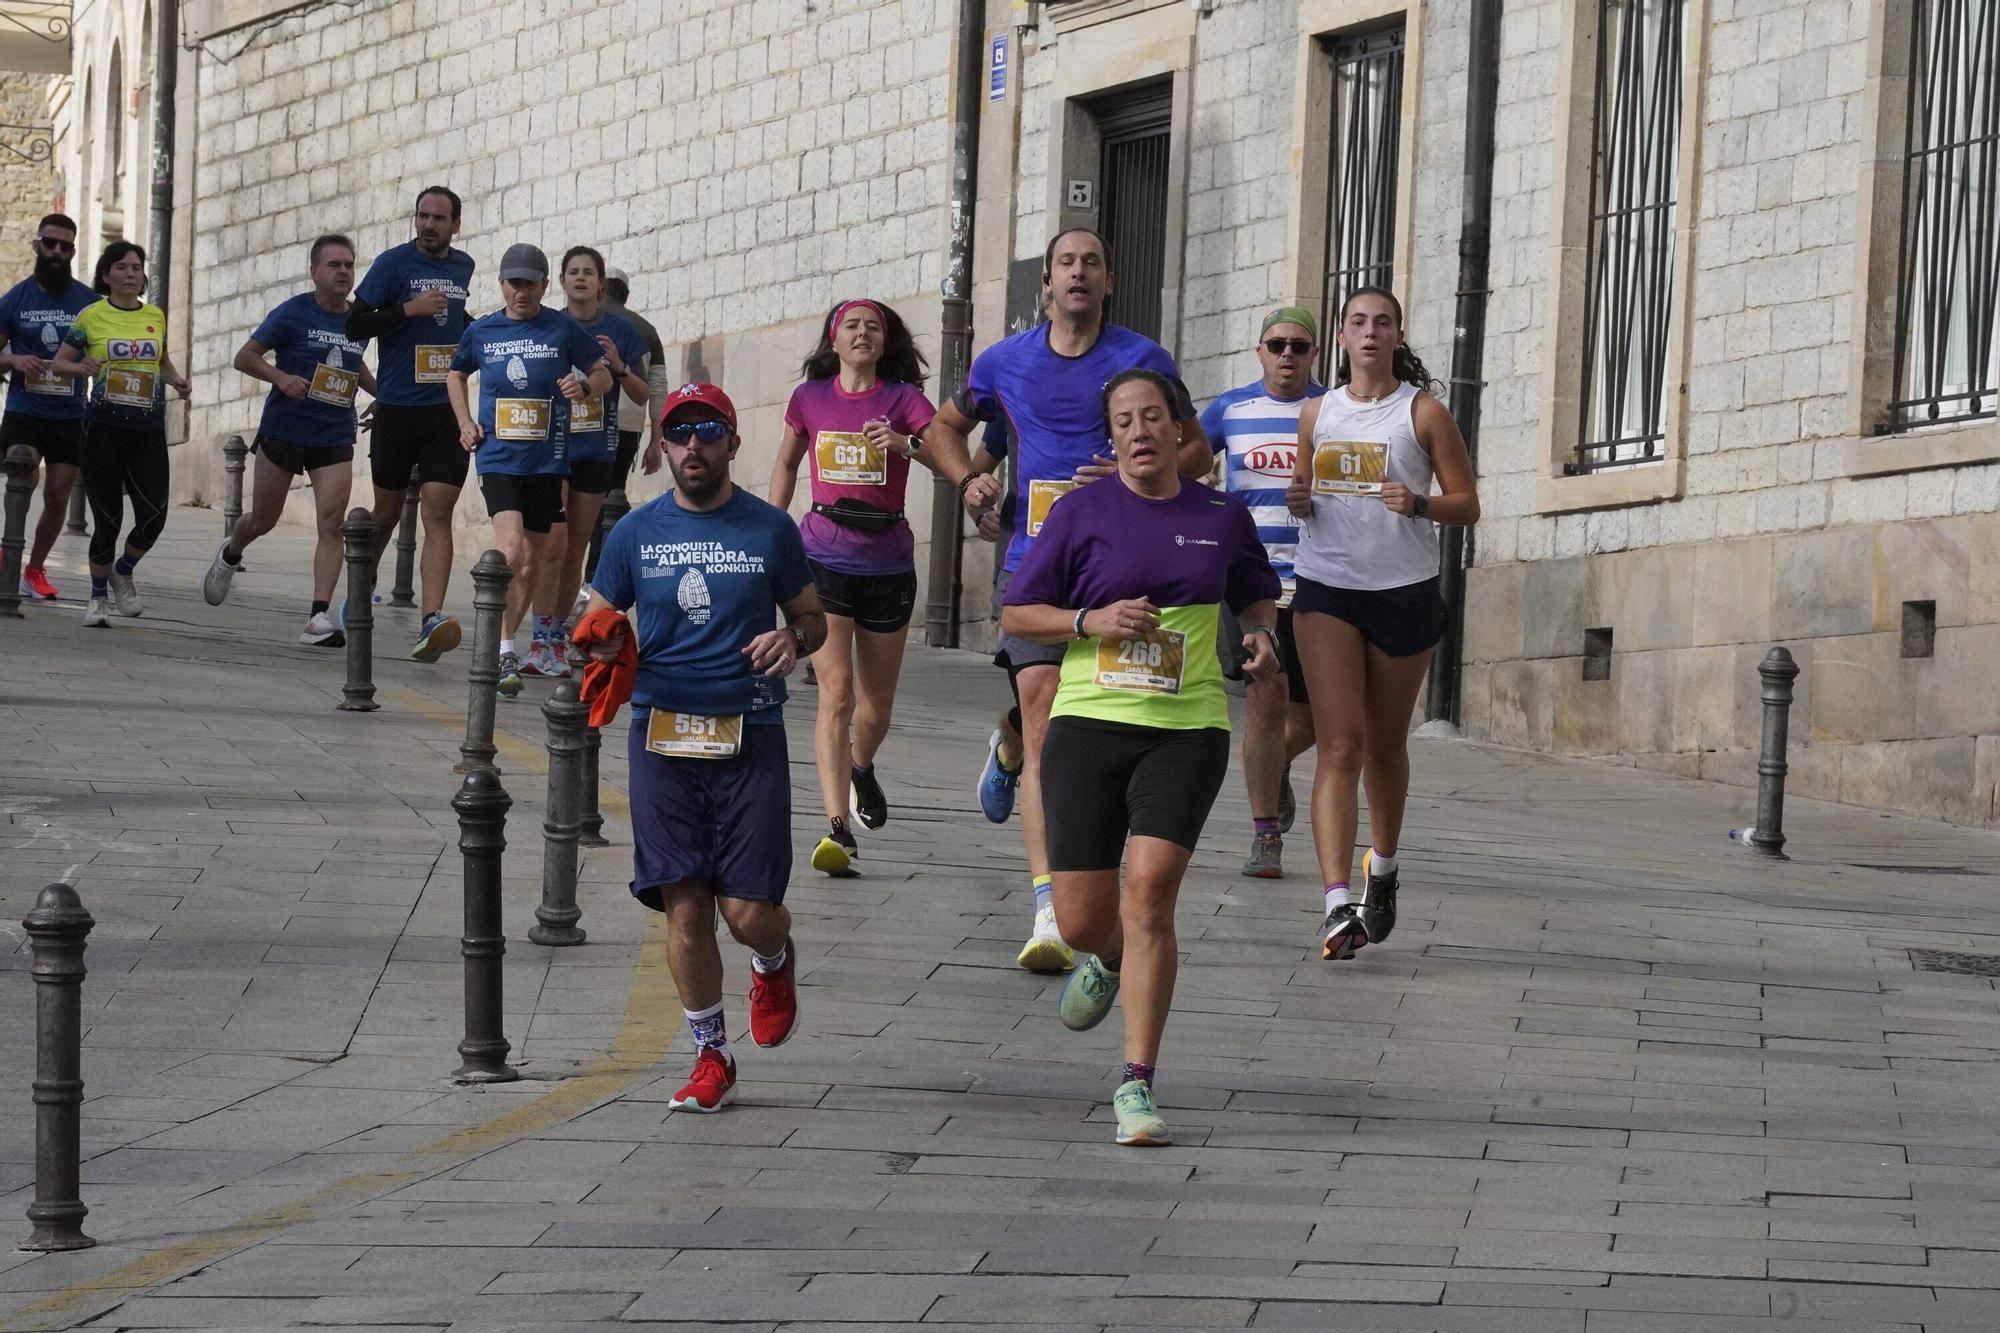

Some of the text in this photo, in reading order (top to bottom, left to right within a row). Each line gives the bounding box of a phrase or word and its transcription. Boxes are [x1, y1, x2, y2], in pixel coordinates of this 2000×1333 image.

[1073, 184, 1087, 203] 5
[492, 339, 534, 349] CONQUISTA
[494, 344, 549, 356] ALMENDRA
[429, 354, 452, 369] 655
[125, 377, 140, 392] 76
[325, 375, 349, 393] 340
[510, 408, 538, 425] 345
[834, 445, 866, 465] 631
[1252, 451, 1297, 469] DAN
[1340, 453, 1361, 475] 61
[641, 542, 723, 554] LA CONQUISTA
[658, 550, 748, 566] ALMENDRA
[706, 563, 765, 574] KONKISTA
[1117, 640, 1162, 667] 268
[675, 713, 717, 736] 551
